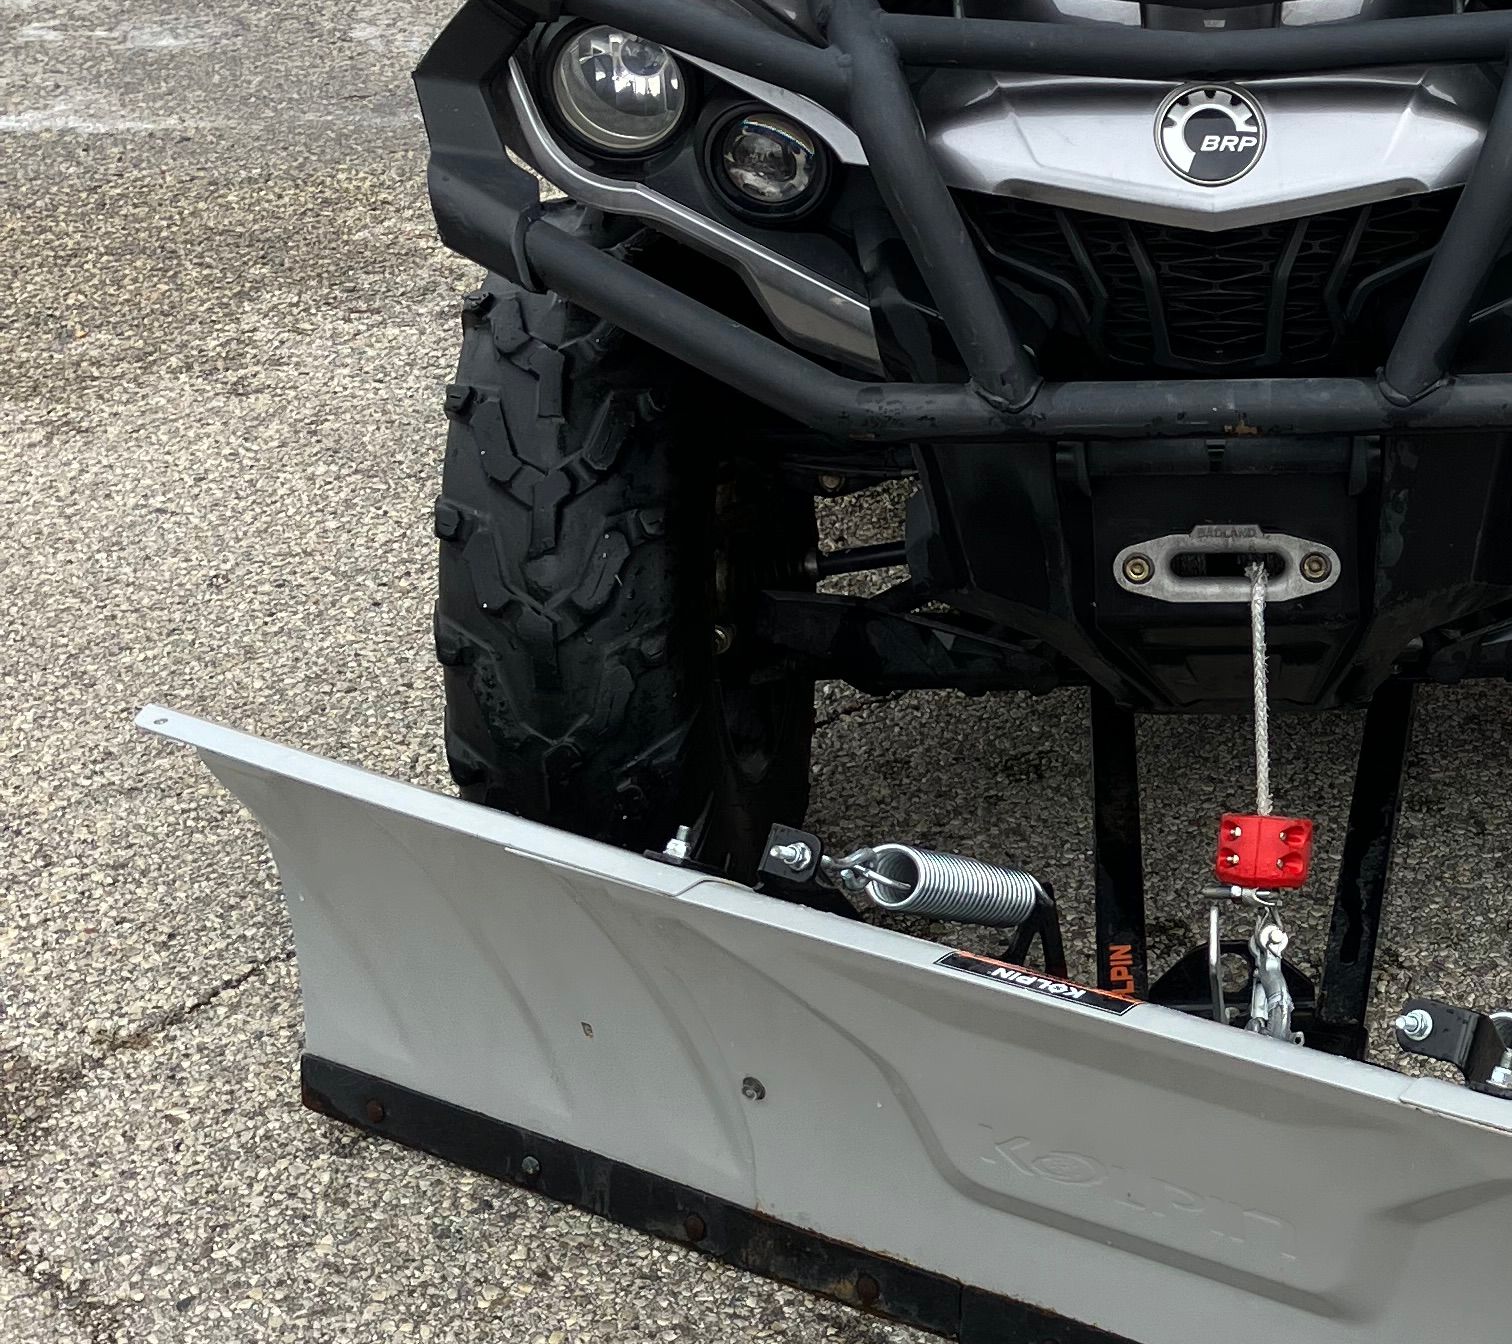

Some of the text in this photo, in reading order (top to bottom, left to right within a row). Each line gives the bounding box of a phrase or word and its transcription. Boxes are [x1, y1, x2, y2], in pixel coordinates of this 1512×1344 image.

[1199, 135, 1258, 152] BRP
[990, 967, 1087, 1000] KOLPIN
[1109, 943, 1135, 996] LPIN
